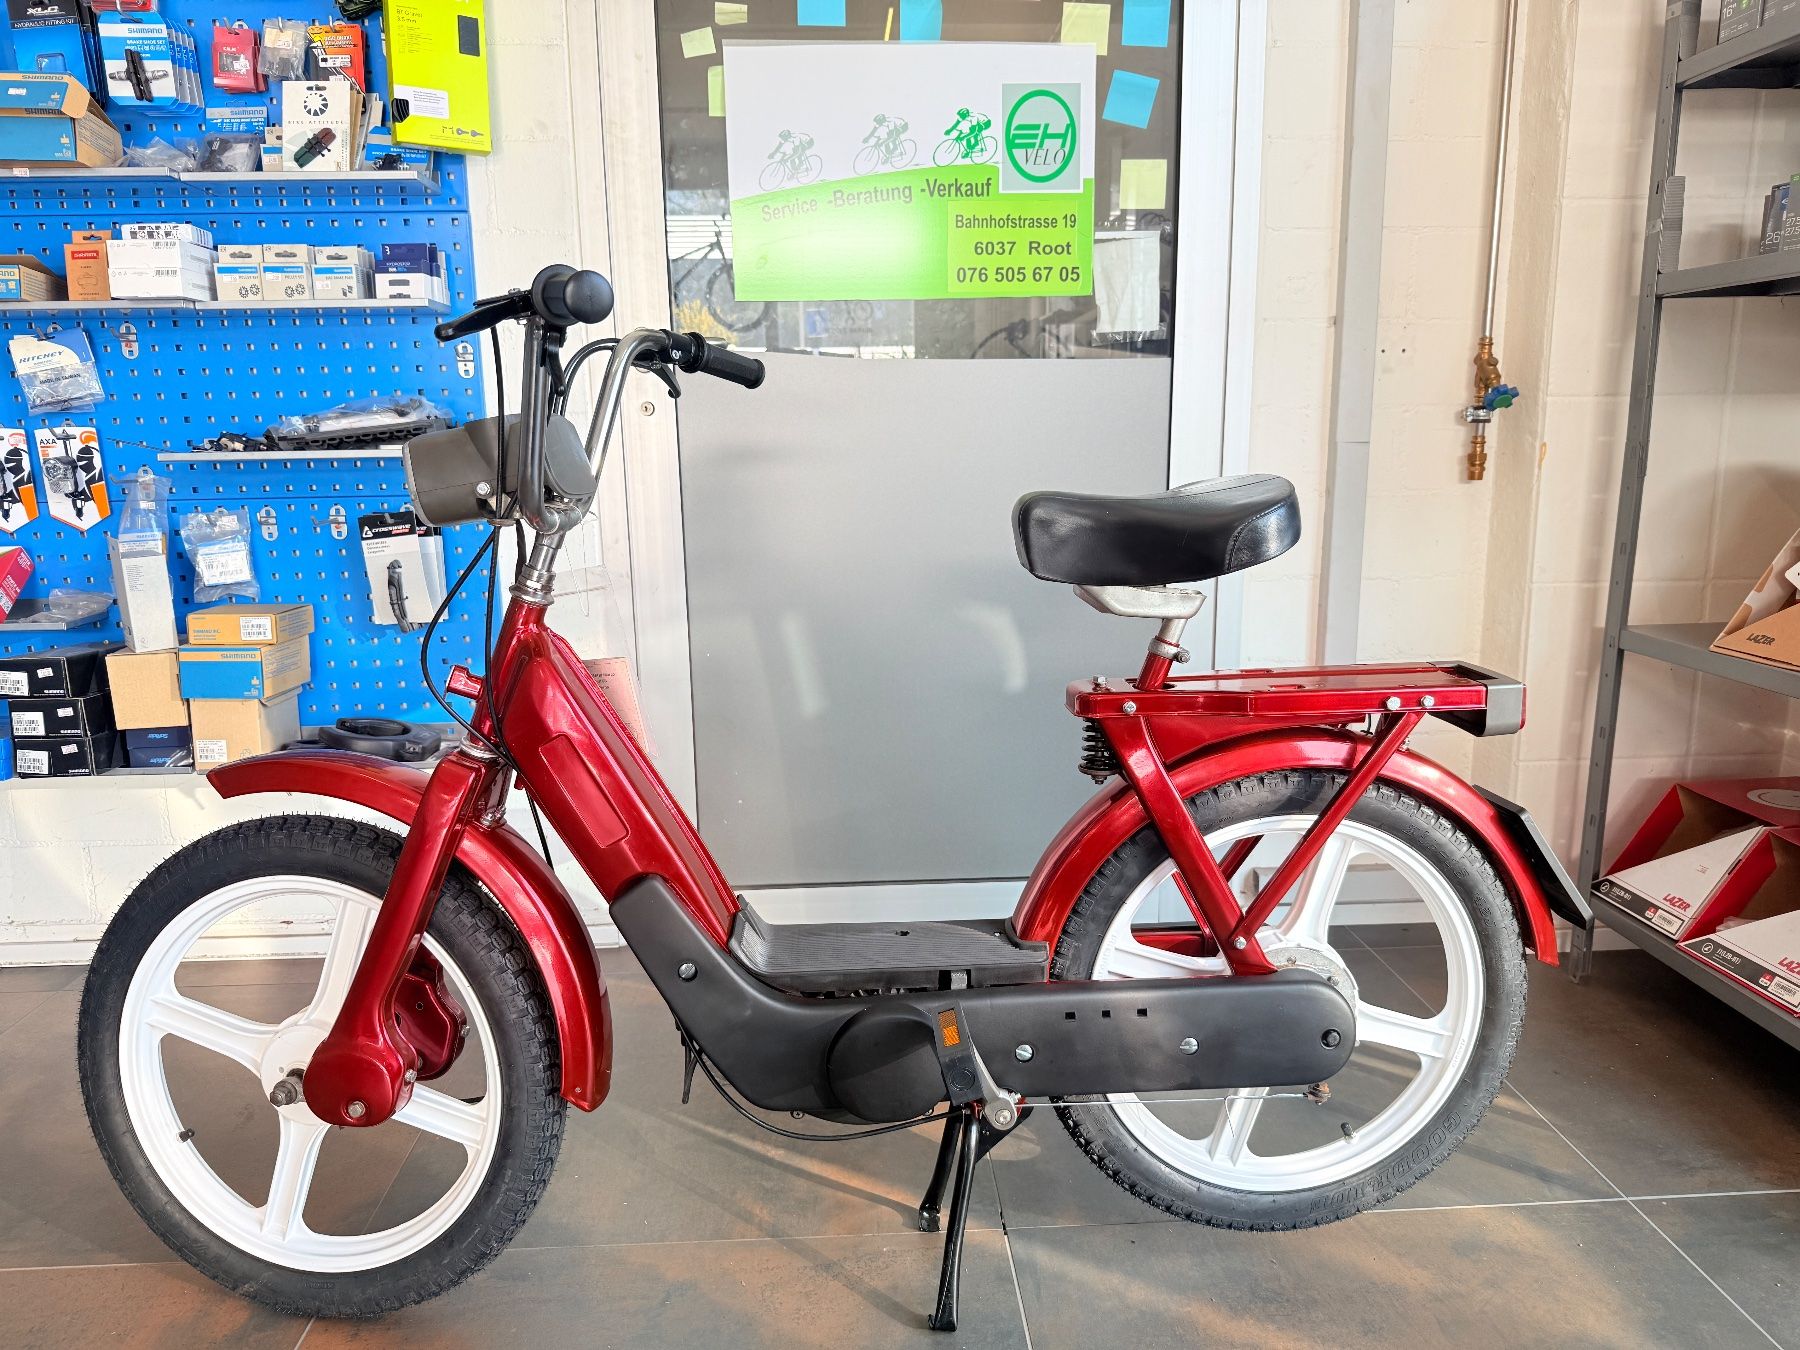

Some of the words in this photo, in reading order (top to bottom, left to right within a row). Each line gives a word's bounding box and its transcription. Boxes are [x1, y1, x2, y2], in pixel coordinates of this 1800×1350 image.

[26, 6, 59, 15] XLC
[1024, 148, 1067, 166] VELO
[761, 197, 818, 223] Service
[826, 185, 913, 208] -Beratung
[919, 178, 992, 198] -Verkauf
[955, 213, 1058, 229] Bahnhofstrasse
[1062, 213, 1077, 228] 19
[974, 241, 1017, 255] 6037
[1028, 240, 1071, 255] Root
[956, 267, 989, 282] 076
[994, 266, 1027, 282] 505
[1032, 266, 1054, 282] 67
[1059, 266, 1080, 282] 05
[19, 350, 64, 364] RITCHEY
[61, 373, 81, 381] TAIWAN
[39, 438, 58, 446] AXA
[1746, 633, 1776, 646] LAZER
[1662, 892, 1691, 913] LAZER
